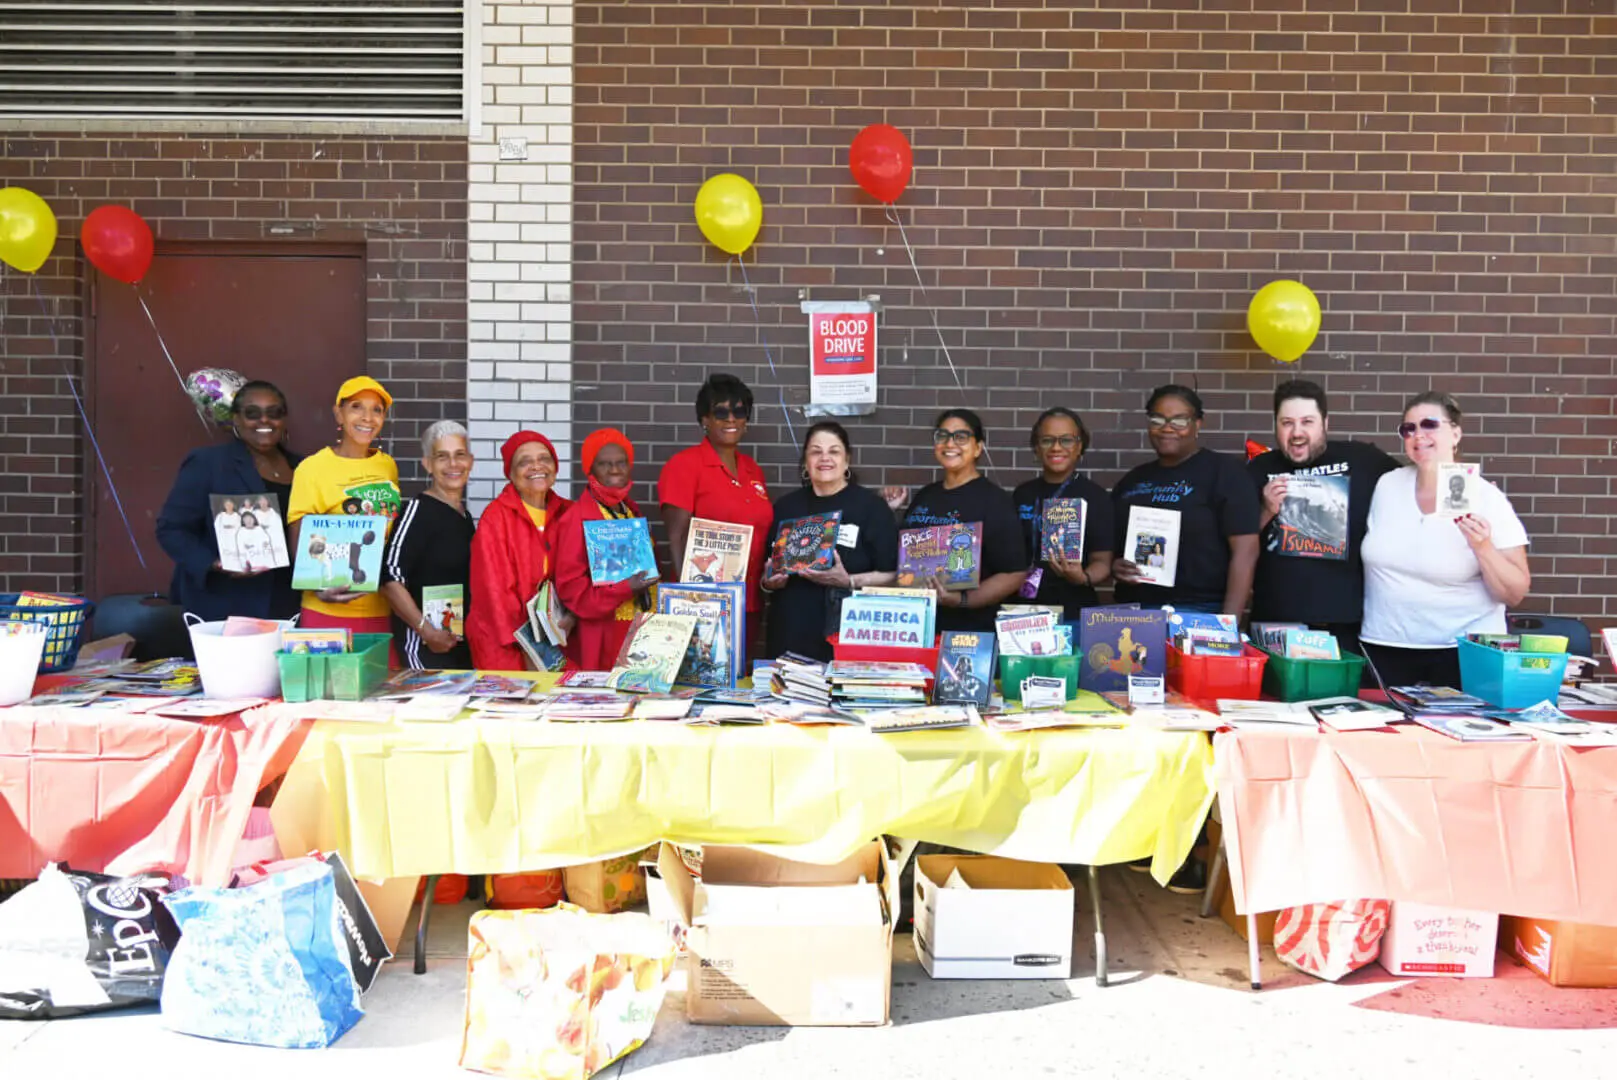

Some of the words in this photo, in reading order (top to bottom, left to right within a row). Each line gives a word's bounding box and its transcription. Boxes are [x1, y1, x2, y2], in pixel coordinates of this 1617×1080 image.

[820, 319, 868, 336] BLOOD
[824, 337, 865, 353] DRIVE
[1294, 462, 1349, 477] BEATLES
[695, 530, 704, 538] THE
[694, 538, 703, 547] THE
[709, 540, 727, 550] LITTLE
[672, 606, 697, 616] Golden
[846, 609, 920, 624] AMERICA
[845, 628, 919, 643] AMERICA
[1413, 918, 1443, 931] Every
